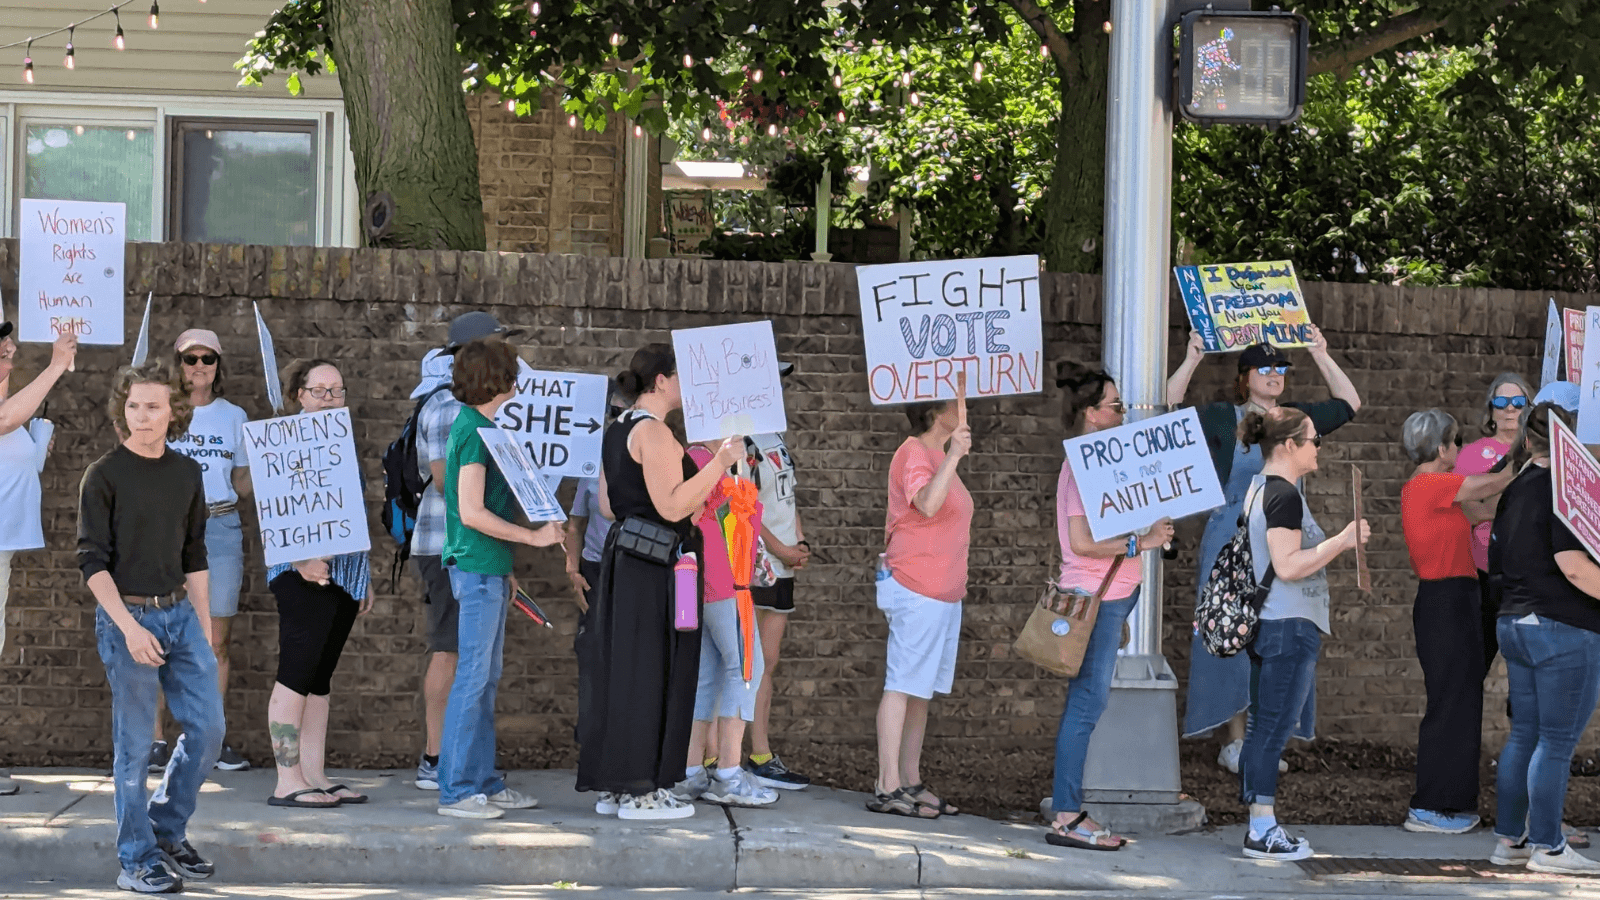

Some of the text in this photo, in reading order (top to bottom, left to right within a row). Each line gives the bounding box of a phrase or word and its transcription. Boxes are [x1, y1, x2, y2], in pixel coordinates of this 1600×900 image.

[37, 206, 115, 236] Women's
[52, 242, 97, 270] Rights
[1202, 266, 1223, 283] I
[871, 267, 1039, 323] FIGHT
[1183, 268, 1216, 350] NAVY VET
[1209, 290, 1299, 314] FREEDOM
[49, 316, 93, 336] Rights
[899, 309, 1011, 359] VOTE
[1261, 320, 1314, 344] MINE
[720, 337, 772, 390] Body
[869, 350, 1040, 401] OVERTURN
[245, 411, 348, 449] WOMEN'S
[500, 401, 574, 436] SHE
[208, 434, 224, 445] as
[1079, 417, 1196, 470] PRO-CHOICE
[260, 443, 342, 478] RIGHTS
[1564, 455, 1587, 489] WITH
[1568, 447, 1596, 485] STAND
[287, 467, 332, 491] ARE
[1099, 464, 1203, 519] ANTI-LIFE
[258, 486, 343, 521] HUMAN
[259, 519, 351, 549] RIGHTS
